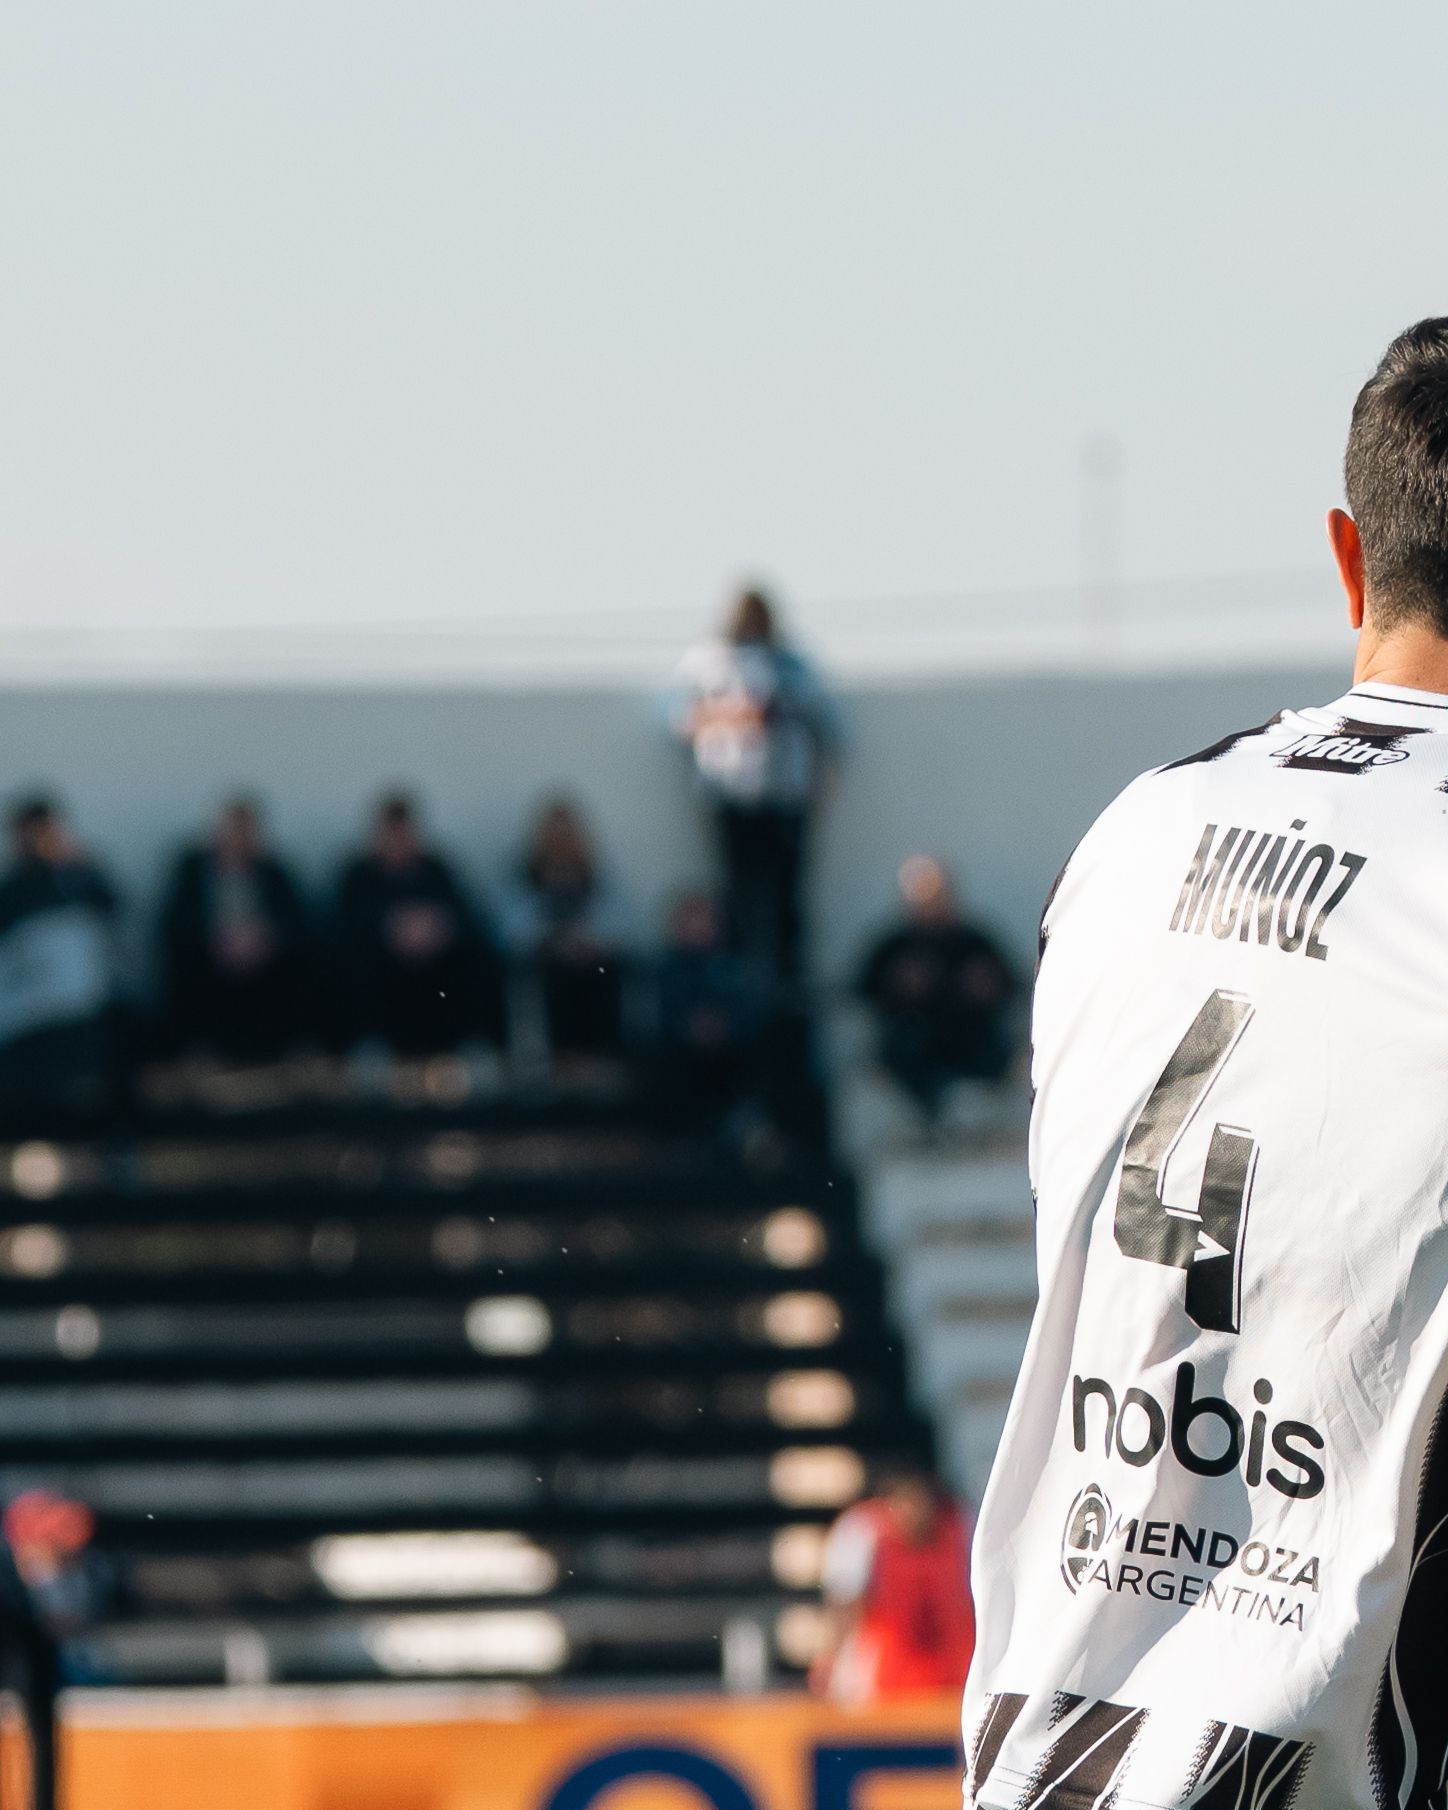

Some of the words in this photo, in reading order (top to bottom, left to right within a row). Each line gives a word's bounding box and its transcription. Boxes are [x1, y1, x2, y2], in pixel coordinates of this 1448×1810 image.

[1168, 818, 1368, 961] MUÑOZ
[1113, 988, 1260, 1335] 4
[1073, 1361, 1325, 1499] nobis
[1088, 1558, 1304, 1632] ARGENTINA
[1106, 1513, 1320, 1593] MENDOZA
